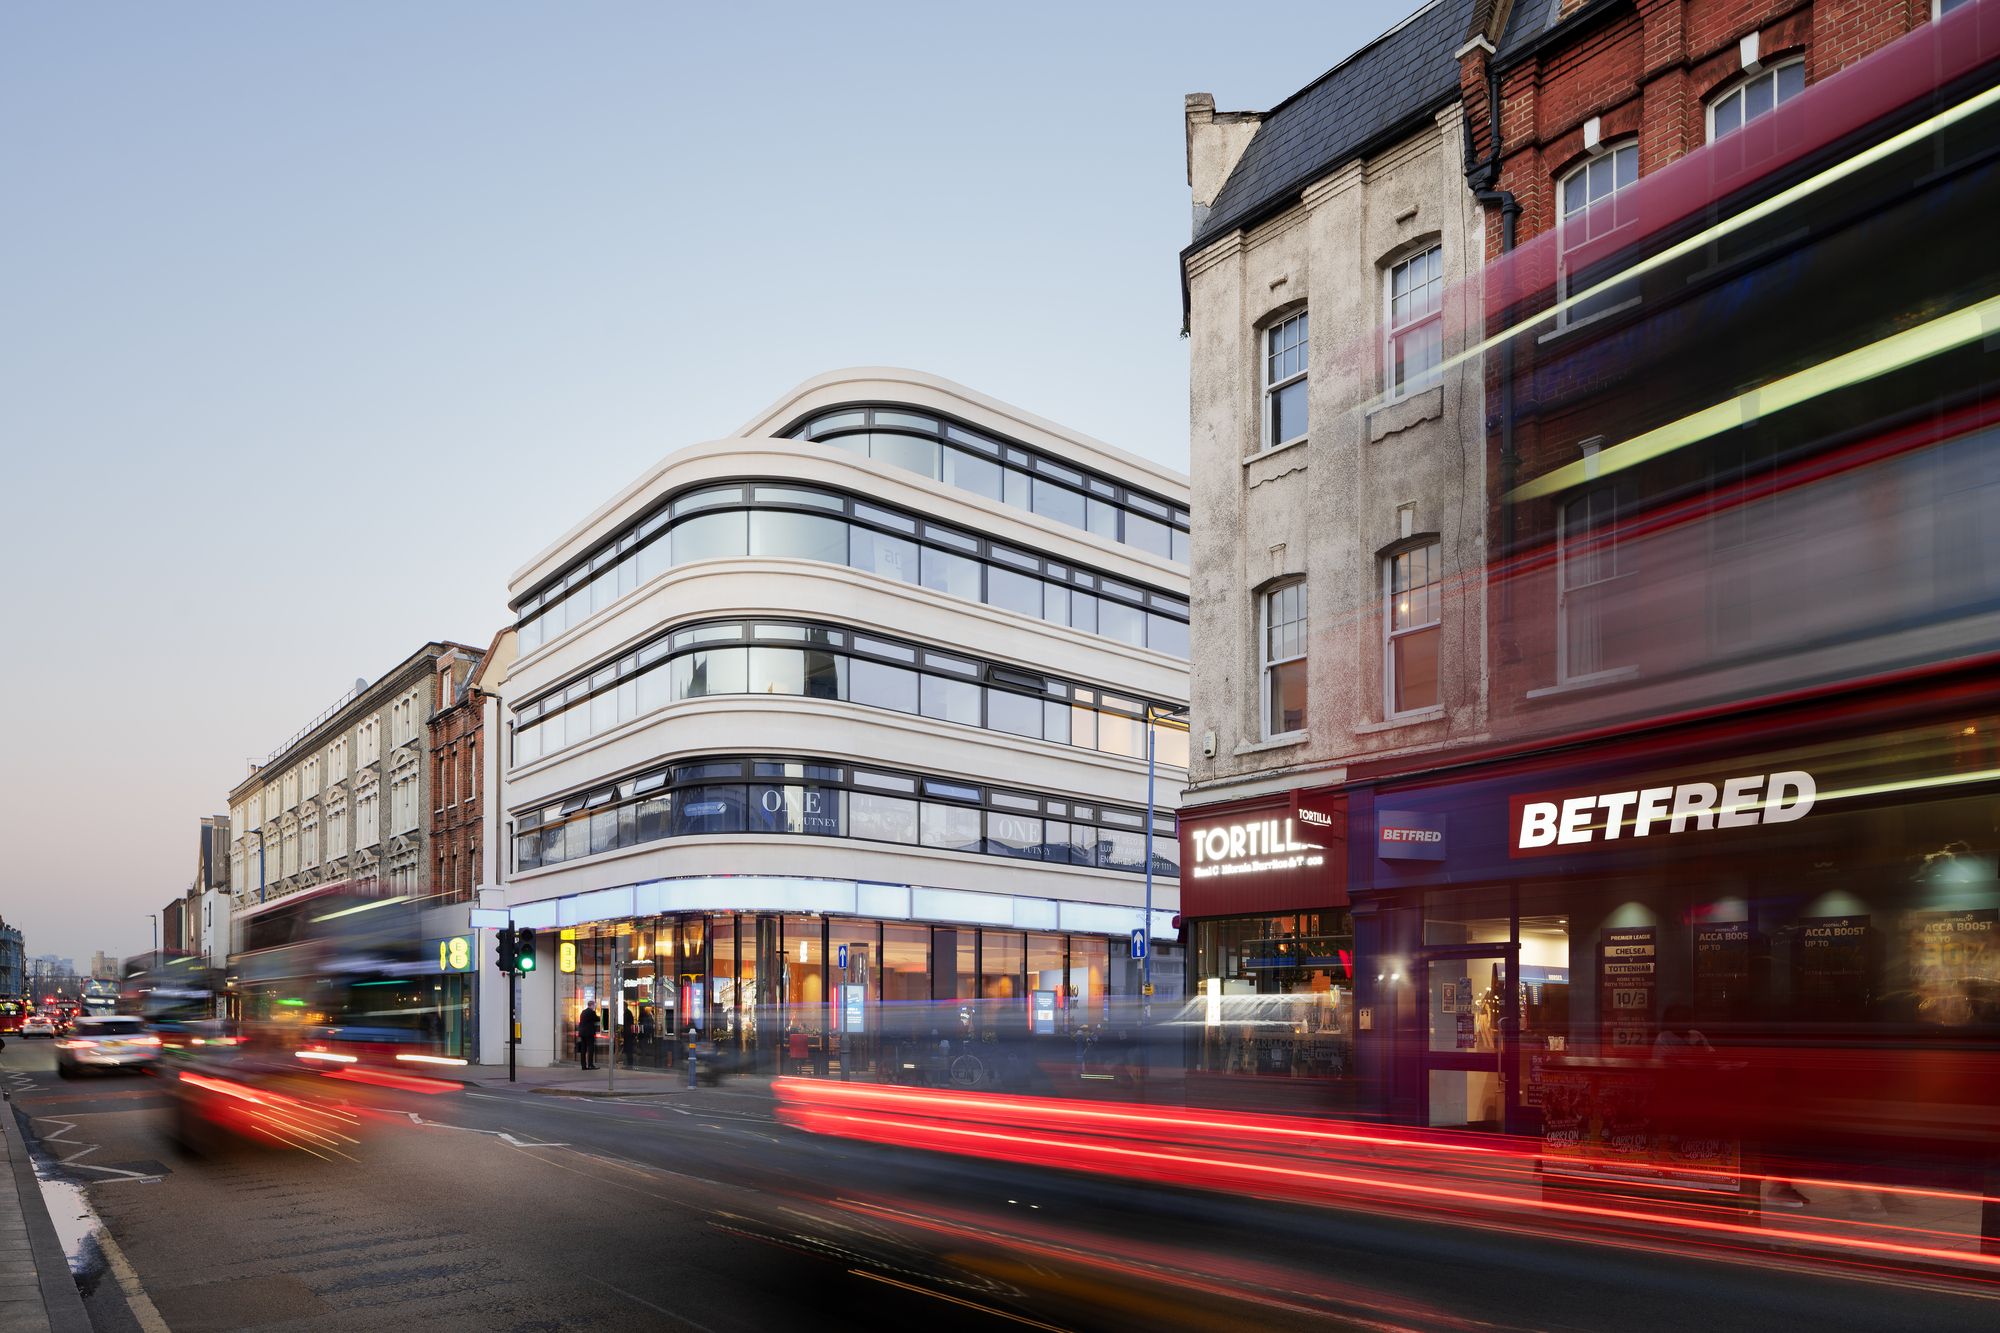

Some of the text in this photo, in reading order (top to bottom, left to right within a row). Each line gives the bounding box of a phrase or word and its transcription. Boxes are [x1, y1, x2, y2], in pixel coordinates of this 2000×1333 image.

[762, 789, 821, 814] ONE
[1299, 808, 1332, 825] TORTILLA
[1517, 771, 1818, 850] BETFRED
[798, 816, 838, 829] UTNEY
[999, 819, 1041, 843] ONE
[1383, 828, 1443, 843] BETFRED
[1193, 818, 1307, 863] TORTILL
[1161, 862, 1173, 872] 1111
[1212, 863, 1251, 876] Clifornia
[1252, 857, 1287, 872] Burritos
[1296, 856, 1323, 867] Tcos
[1804, 926, 1866, 937] ACCA BOOST
[1924, 921, 1993, 933] ACCA BOOST
[1633, 933, 1651, 941] LEAGUE
[1698, 931, 1749, 942] ACCA BOOS
[1938, 935, 1951, 943] TO
[1698, 943, 1721, 952] UP TO
[1804, 940, 1829, 948] UP TO
[1615, 947, 1647, 956] CHELSEA
[1608, 965, 1652, 973] TOTTENHAM
[1615, 991, 1647, 1007] 10/3
